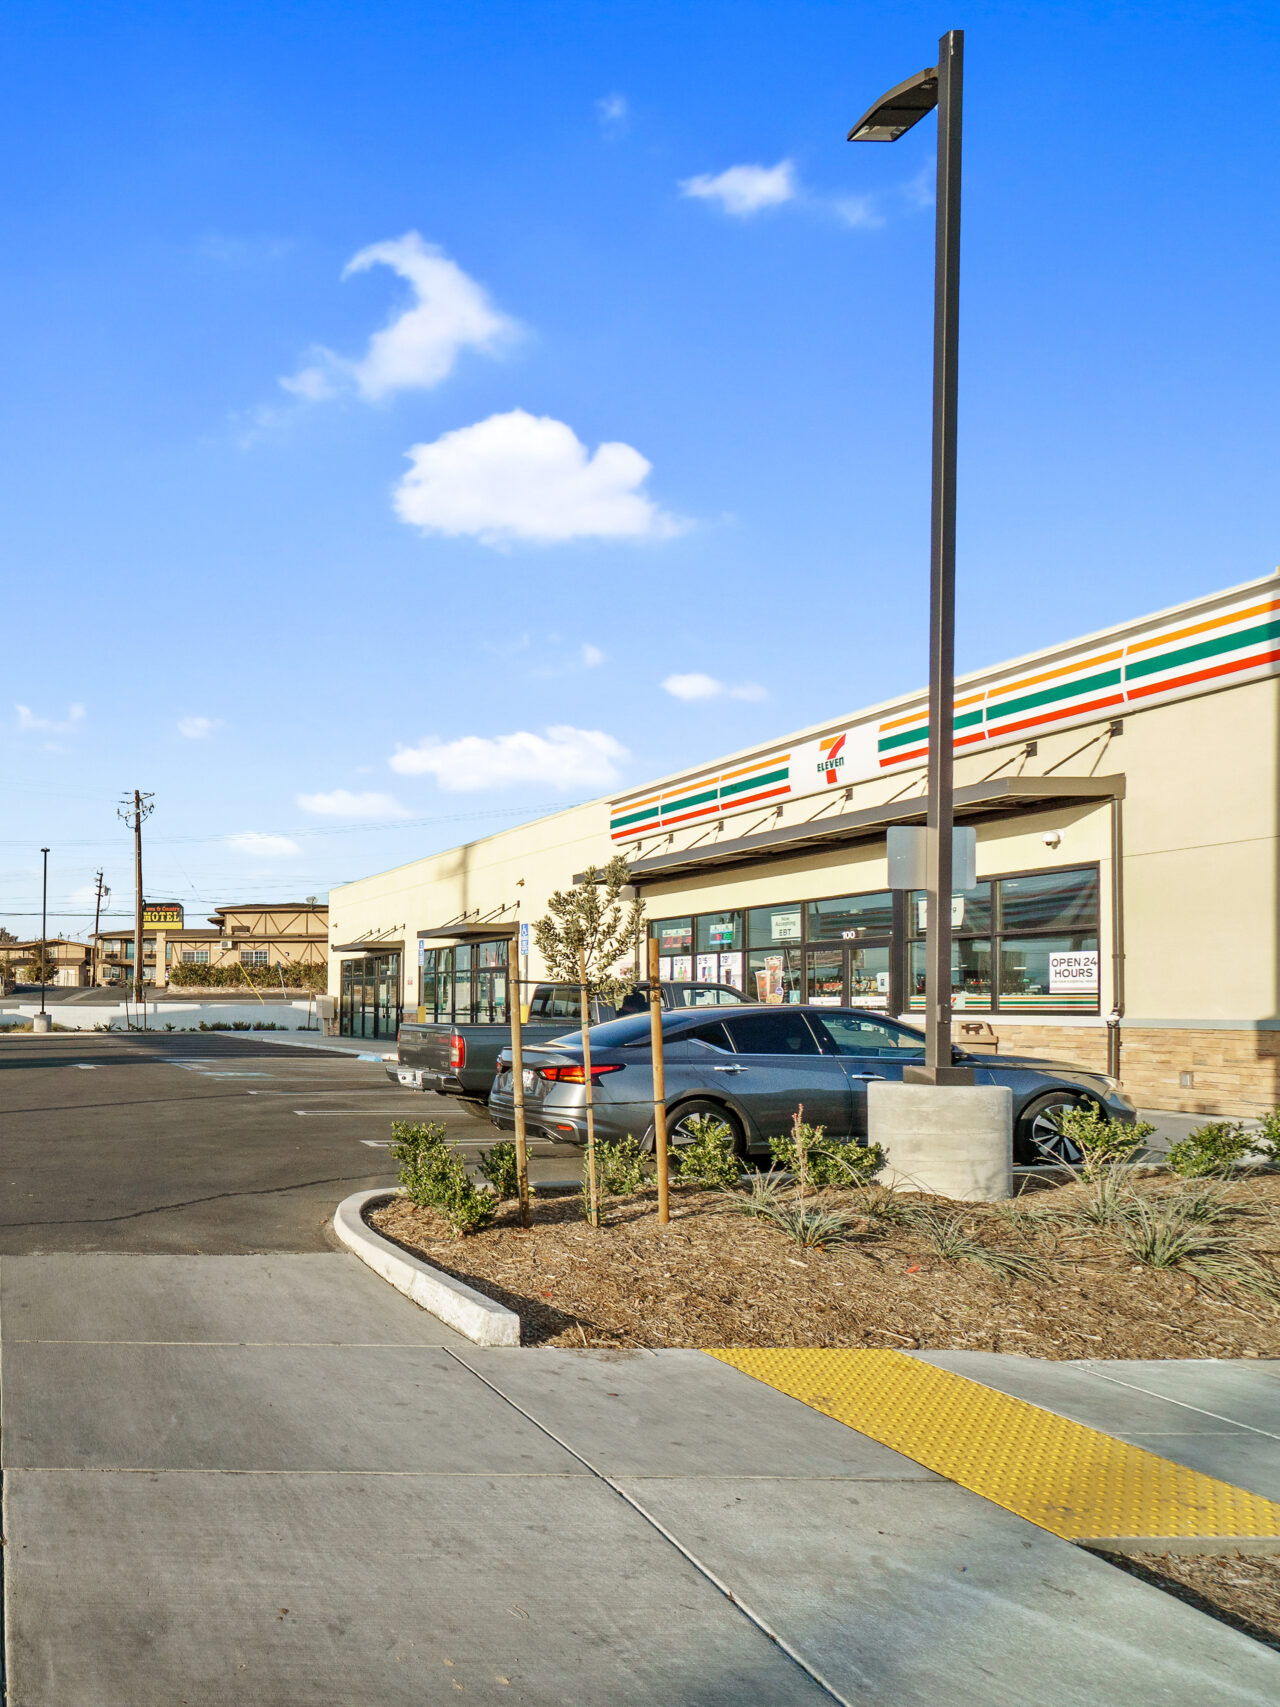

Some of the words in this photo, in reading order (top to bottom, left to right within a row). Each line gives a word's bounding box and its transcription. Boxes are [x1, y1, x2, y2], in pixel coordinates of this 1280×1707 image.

[819, 733, 846, 784] 7
[143, 911, 180, 922] MOTEL
[778, 928, 792, 936] EBT
[842, 931, 856, 939] 100
[1051, 958, 1081, 967] OPEN
[1083, 957, 1098, 966] 24
[1054, 968, 1093, 978] HOURS
